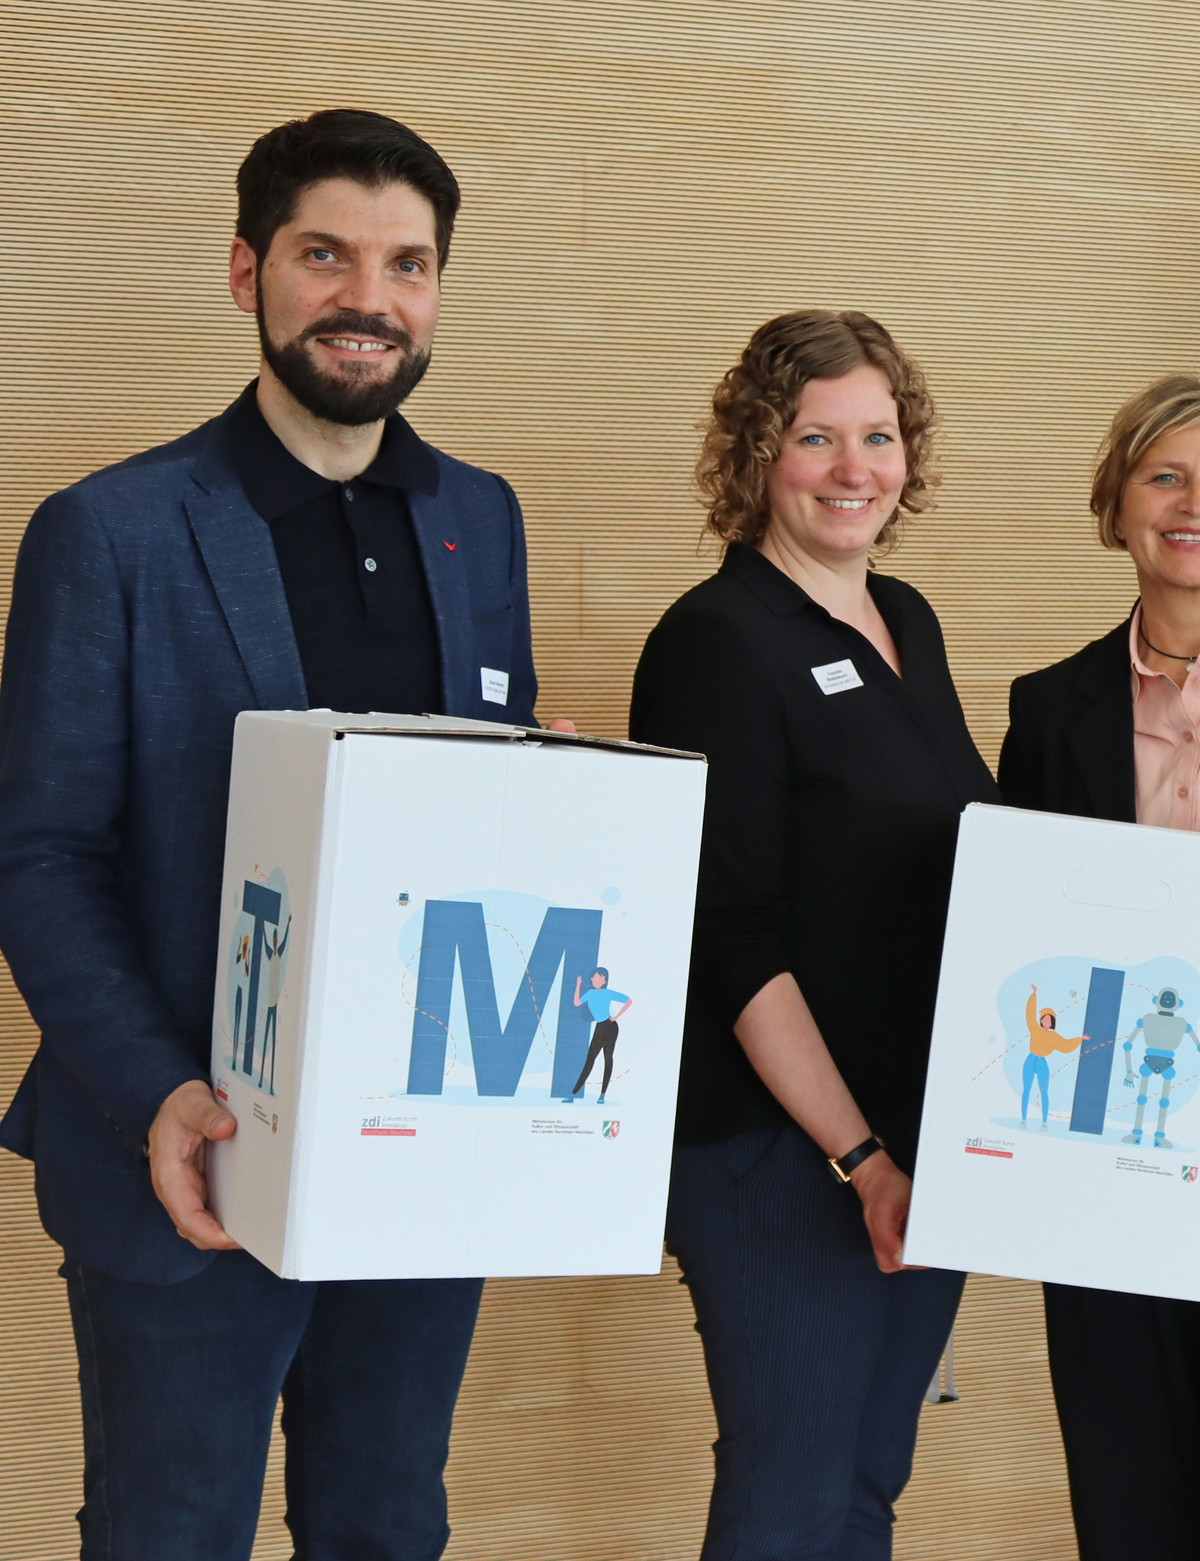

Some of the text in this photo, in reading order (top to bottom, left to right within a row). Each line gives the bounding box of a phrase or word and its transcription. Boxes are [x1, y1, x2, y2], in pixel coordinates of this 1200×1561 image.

[407, 900, 604, 1099] M
[362, 1116, 381, 1127] zdi
[966, 1137, 983, 1147] zdi
